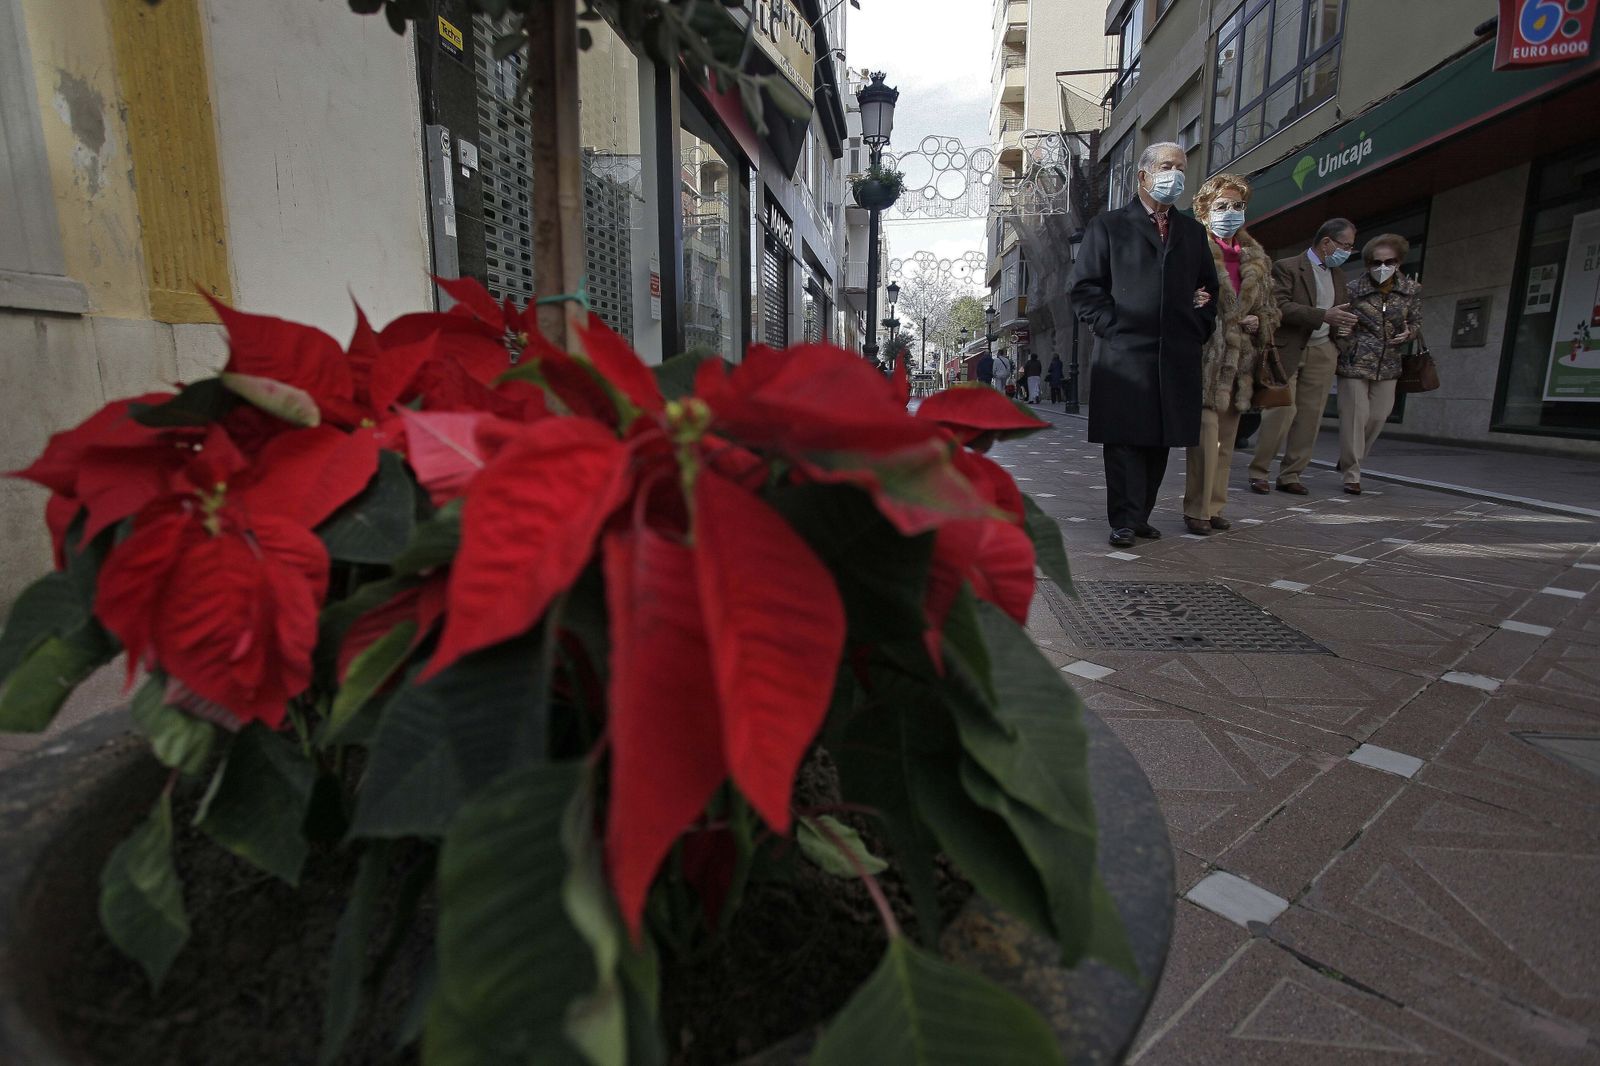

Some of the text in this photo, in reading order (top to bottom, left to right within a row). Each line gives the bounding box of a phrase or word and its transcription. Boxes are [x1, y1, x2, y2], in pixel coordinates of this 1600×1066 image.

[1512, 41, 1588, 59] EURO 6000
[1318, 131, 1373, 177] Unicaja
[771, 204, 793, 250] MANGO
